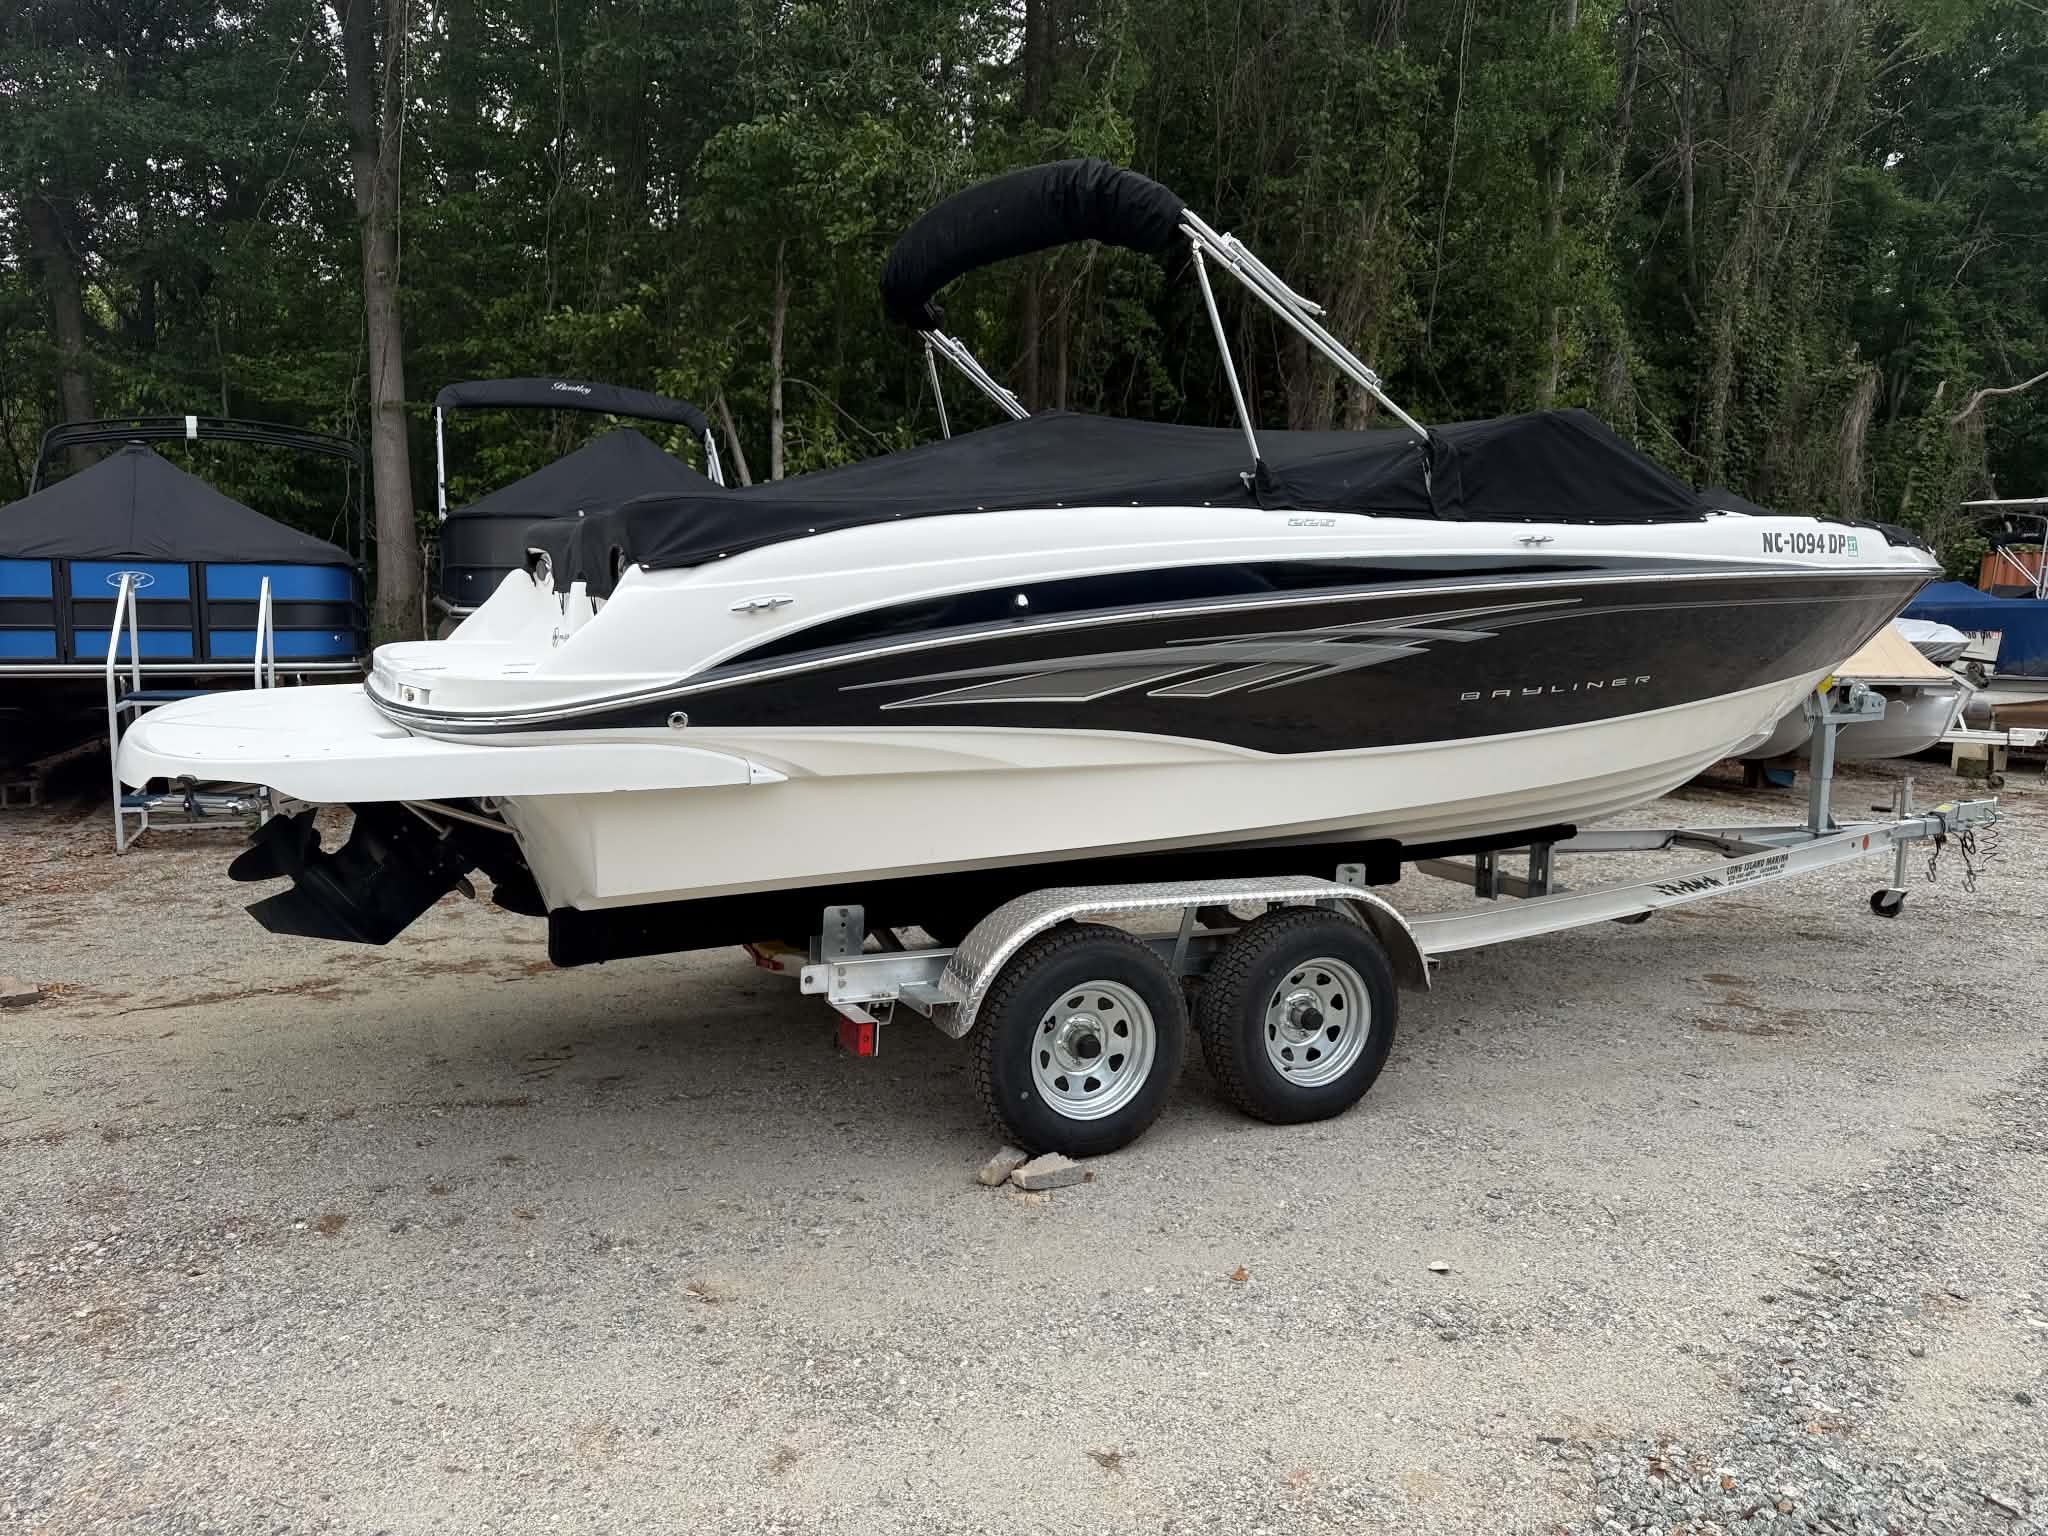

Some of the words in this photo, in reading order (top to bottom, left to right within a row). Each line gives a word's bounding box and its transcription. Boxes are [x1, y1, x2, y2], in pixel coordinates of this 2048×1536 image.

[1762, 532, 1825, 554] NC-1094
[1828, 533, 1846, 554] DP
[1461, 675, 1651, 701] BAYLINER
[1726, 864, 1744, 876] LONG
